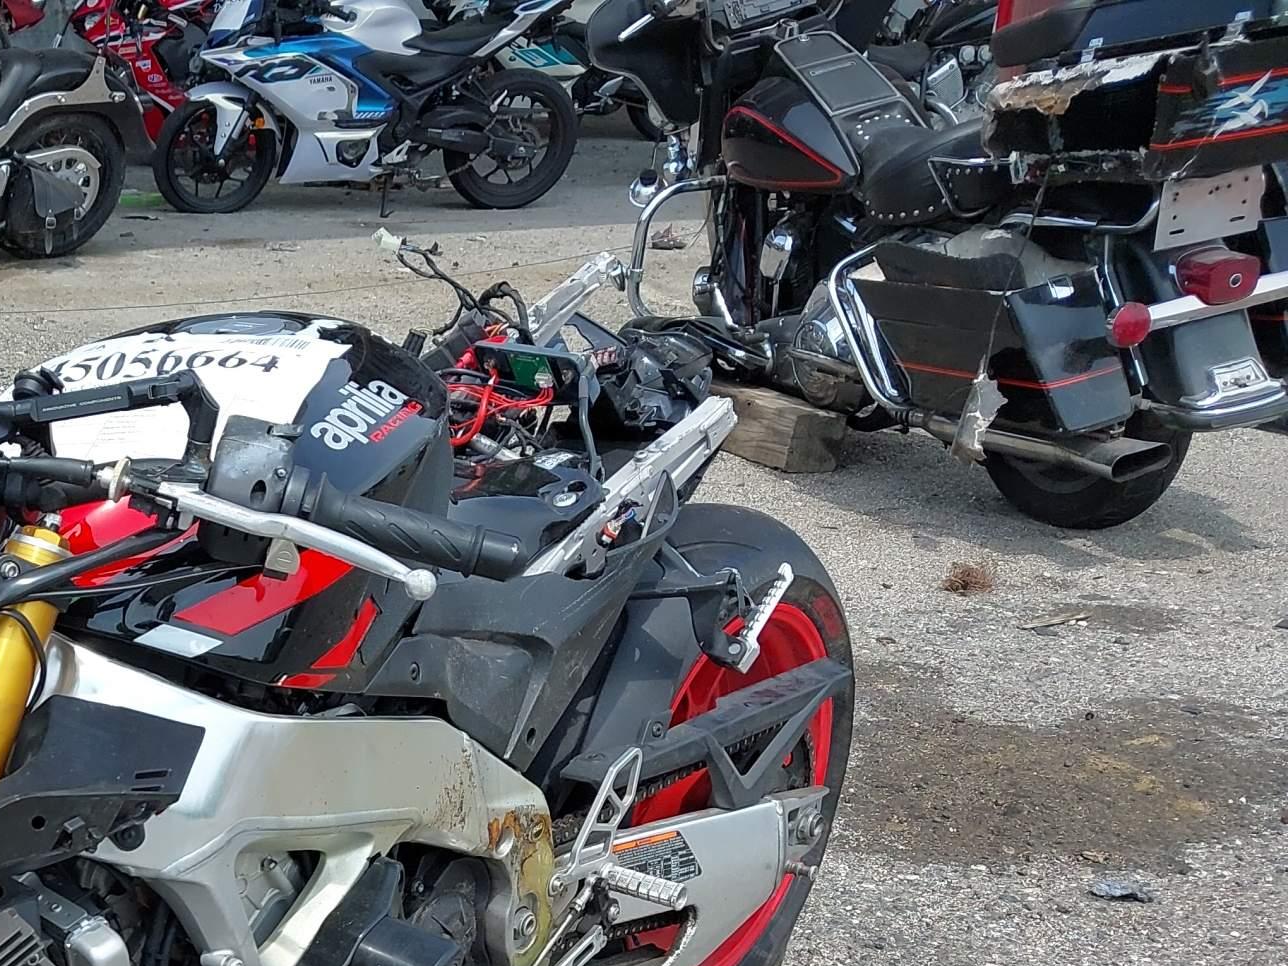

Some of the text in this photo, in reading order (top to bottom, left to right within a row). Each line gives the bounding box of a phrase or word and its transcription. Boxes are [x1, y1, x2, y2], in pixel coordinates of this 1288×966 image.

[309, 75, 333, 85] YAMAHA
[311, 380, 410, 450] aprilia
[369, 400, 423, 442] RACING
